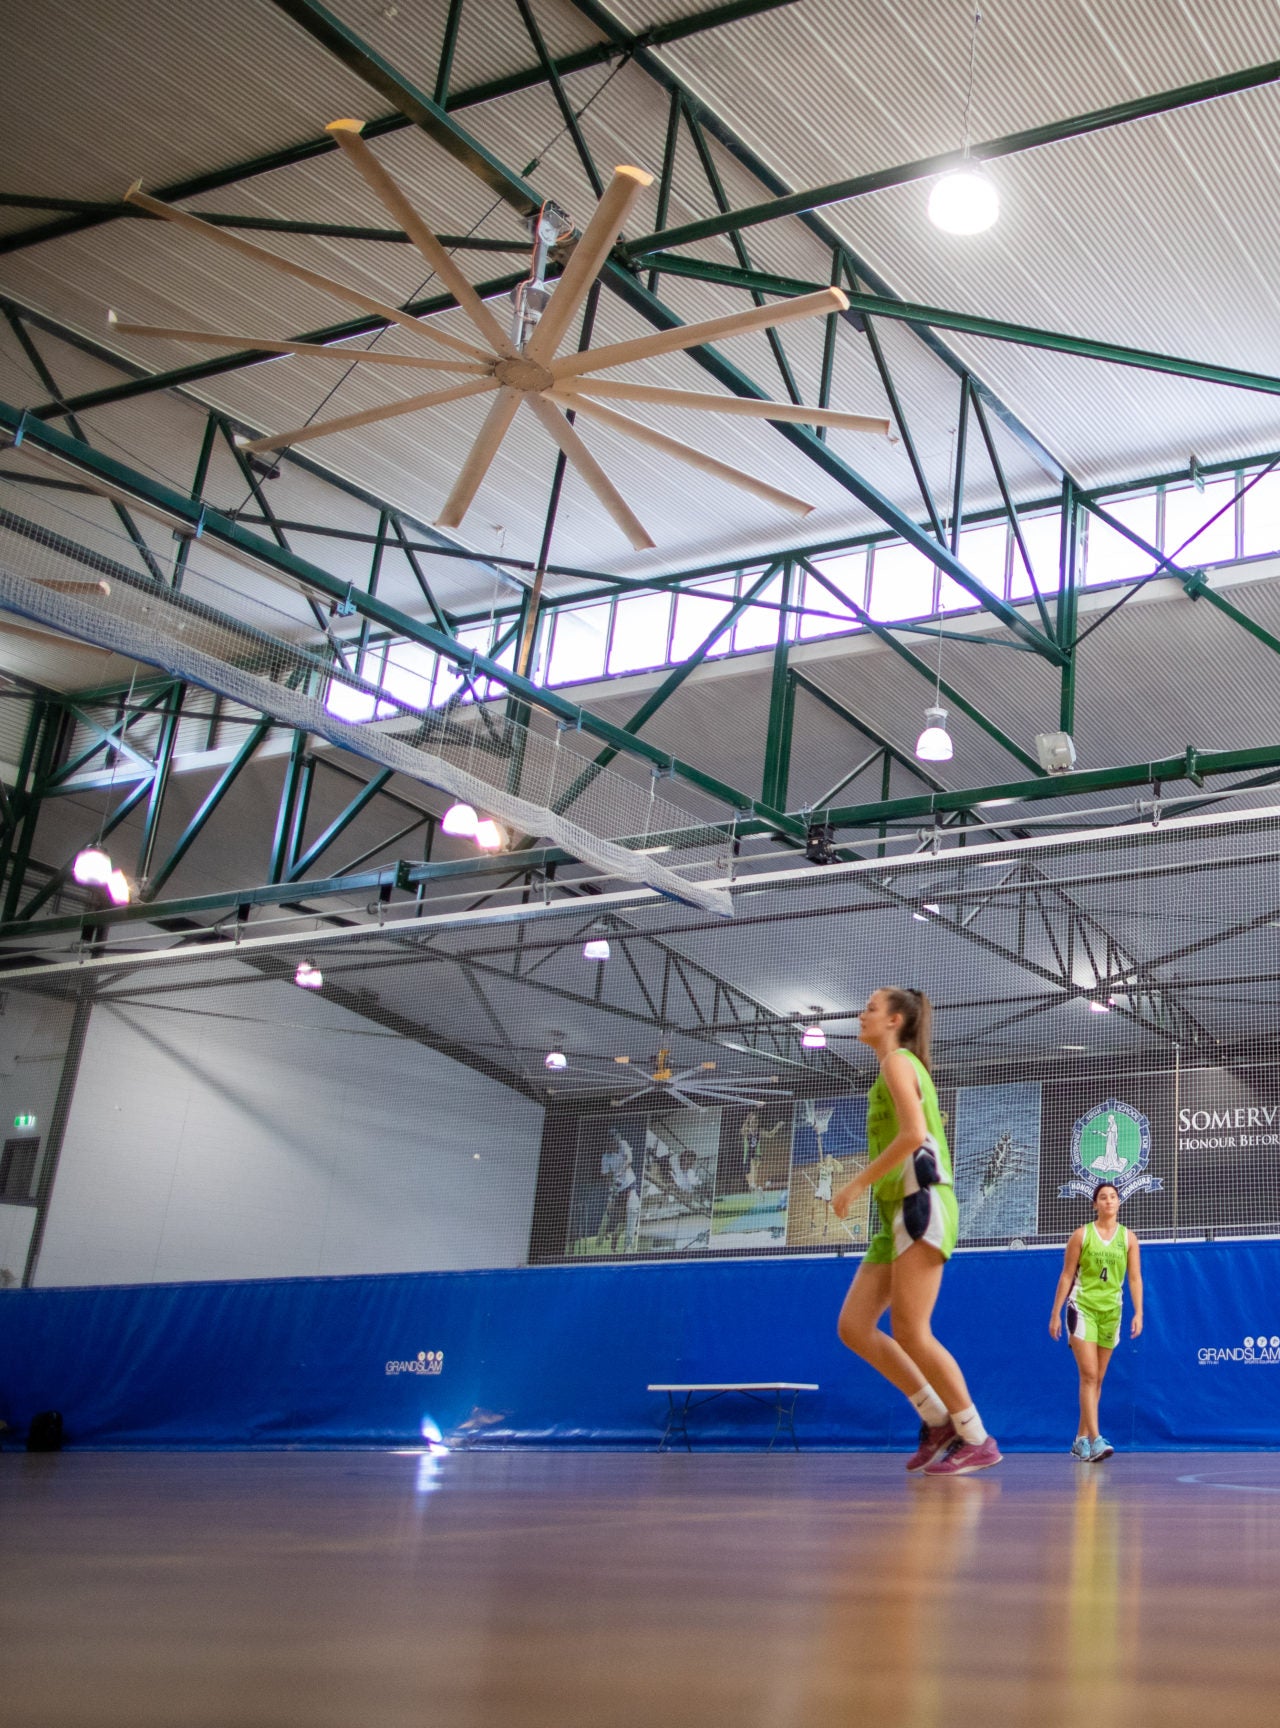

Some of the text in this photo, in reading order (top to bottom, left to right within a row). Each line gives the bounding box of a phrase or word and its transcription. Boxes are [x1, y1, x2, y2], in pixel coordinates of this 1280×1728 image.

[1179, 1136, 1236, 1150] HONOUR
[1071, 1176, 1151, 1198] HONOU HONOURS
[1100, 1267, 1108, 1282] 4
[1197, 1347, 1280, 1361] GRANDSLAM
[385, 1361, 443, 1372] GRANDSLAM
